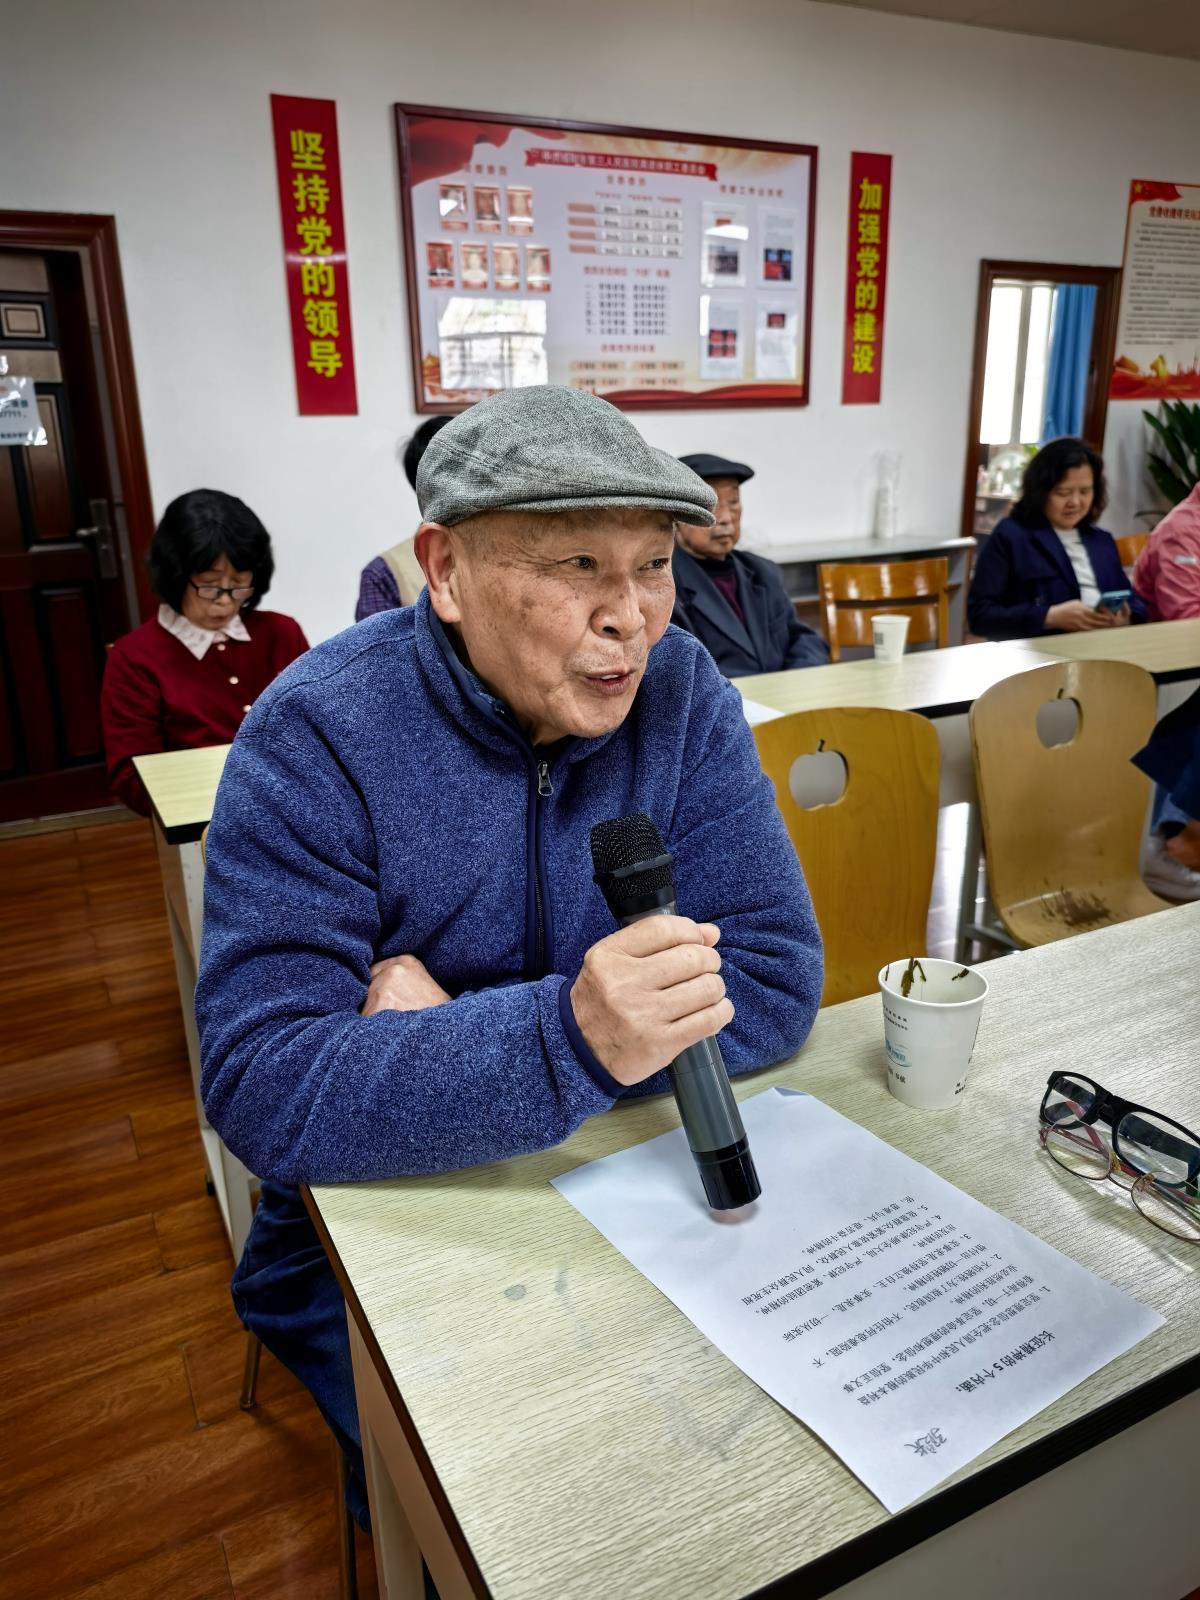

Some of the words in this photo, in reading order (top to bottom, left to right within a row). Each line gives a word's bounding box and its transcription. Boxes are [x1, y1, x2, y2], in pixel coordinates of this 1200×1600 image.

[290, 129, 343, 378] 坚持党的领导
[852, 177, 882, 374] 加强党的建设
[912, 1223, 958, 1249] 出发的精神。
